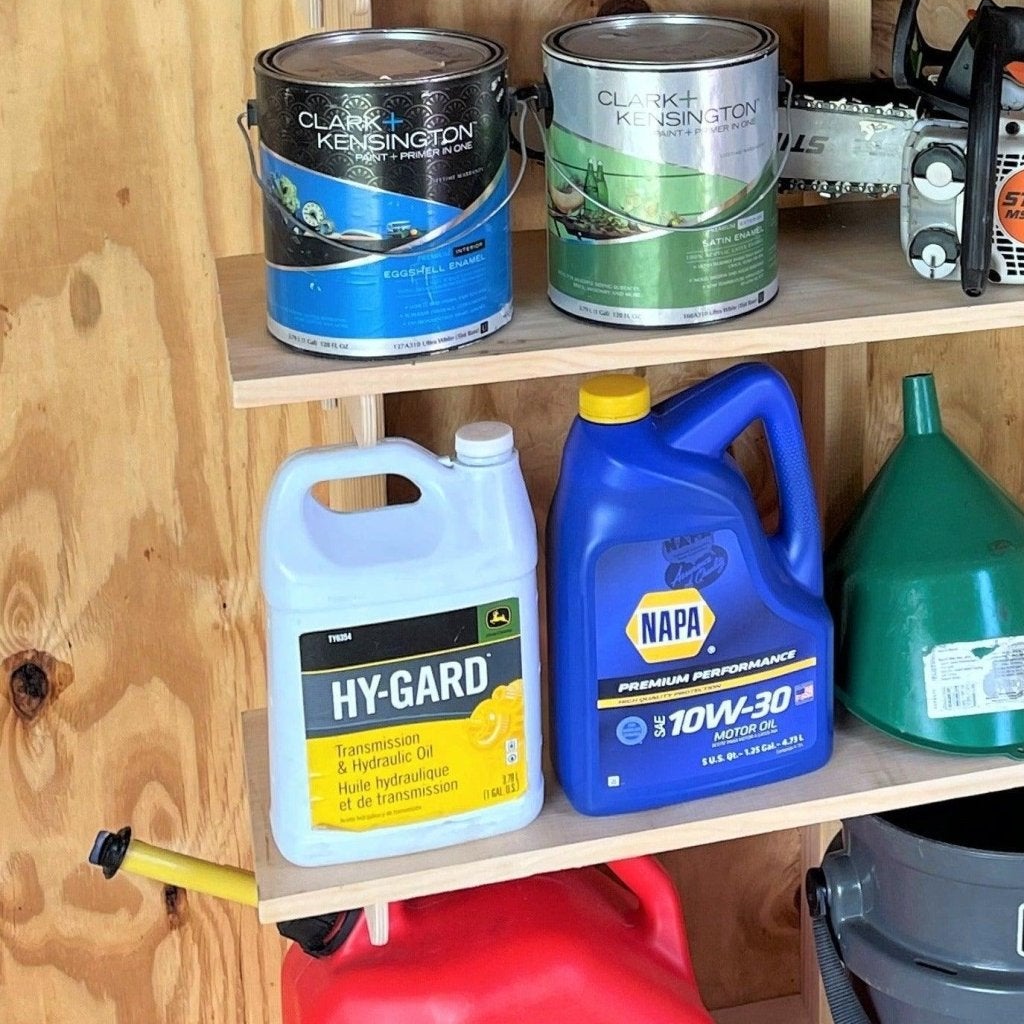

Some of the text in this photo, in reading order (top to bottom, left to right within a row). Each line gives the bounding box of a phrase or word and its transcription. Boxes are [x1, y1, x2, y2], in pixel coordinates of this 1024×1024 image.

[597, 90, 679, 108] CLARK
[298, 111, 382, 131] CLARK
[616, 102, 758, 127] KENSINGTON
[316, 124, 474, 151] KENSINGTON
[355, 151, 388, 163] PAINT
[400, 148, 440, 161] PRIMER
[442, 146, 452, 155] IN
[453, 142, 474, 153] ONE
[455, 241, 484, 254] INTERIOR
[702, 236, 732, 247] SATIN
[734, 225, 764, 242] ENAMEL
[383, 253, 486, 279] EGGSHELL ENAMEL
[641, 606, 701, 645] NAPA
[618, 649, 797, 694] PREMIUM PERFORMANCE
[331, 655, 489, 721] HY-GARD
[668, 685, 792, 736] 10W-30
[654, 715, 666, 738] SAE
[714, 723, 757, 742] MOTOR
[759, 719, 778, 732] OIL
[335, 733, 420, 758] Transmission
[708, 754, 725, 765] U.S.
[744, 745, 761, 756] 1.25
[337, 745, 434, 775] & Hydraulic Oil
[338, 765, 451, 796] Huile hydraulique
[339, 780, 459, 812] et de transmission
